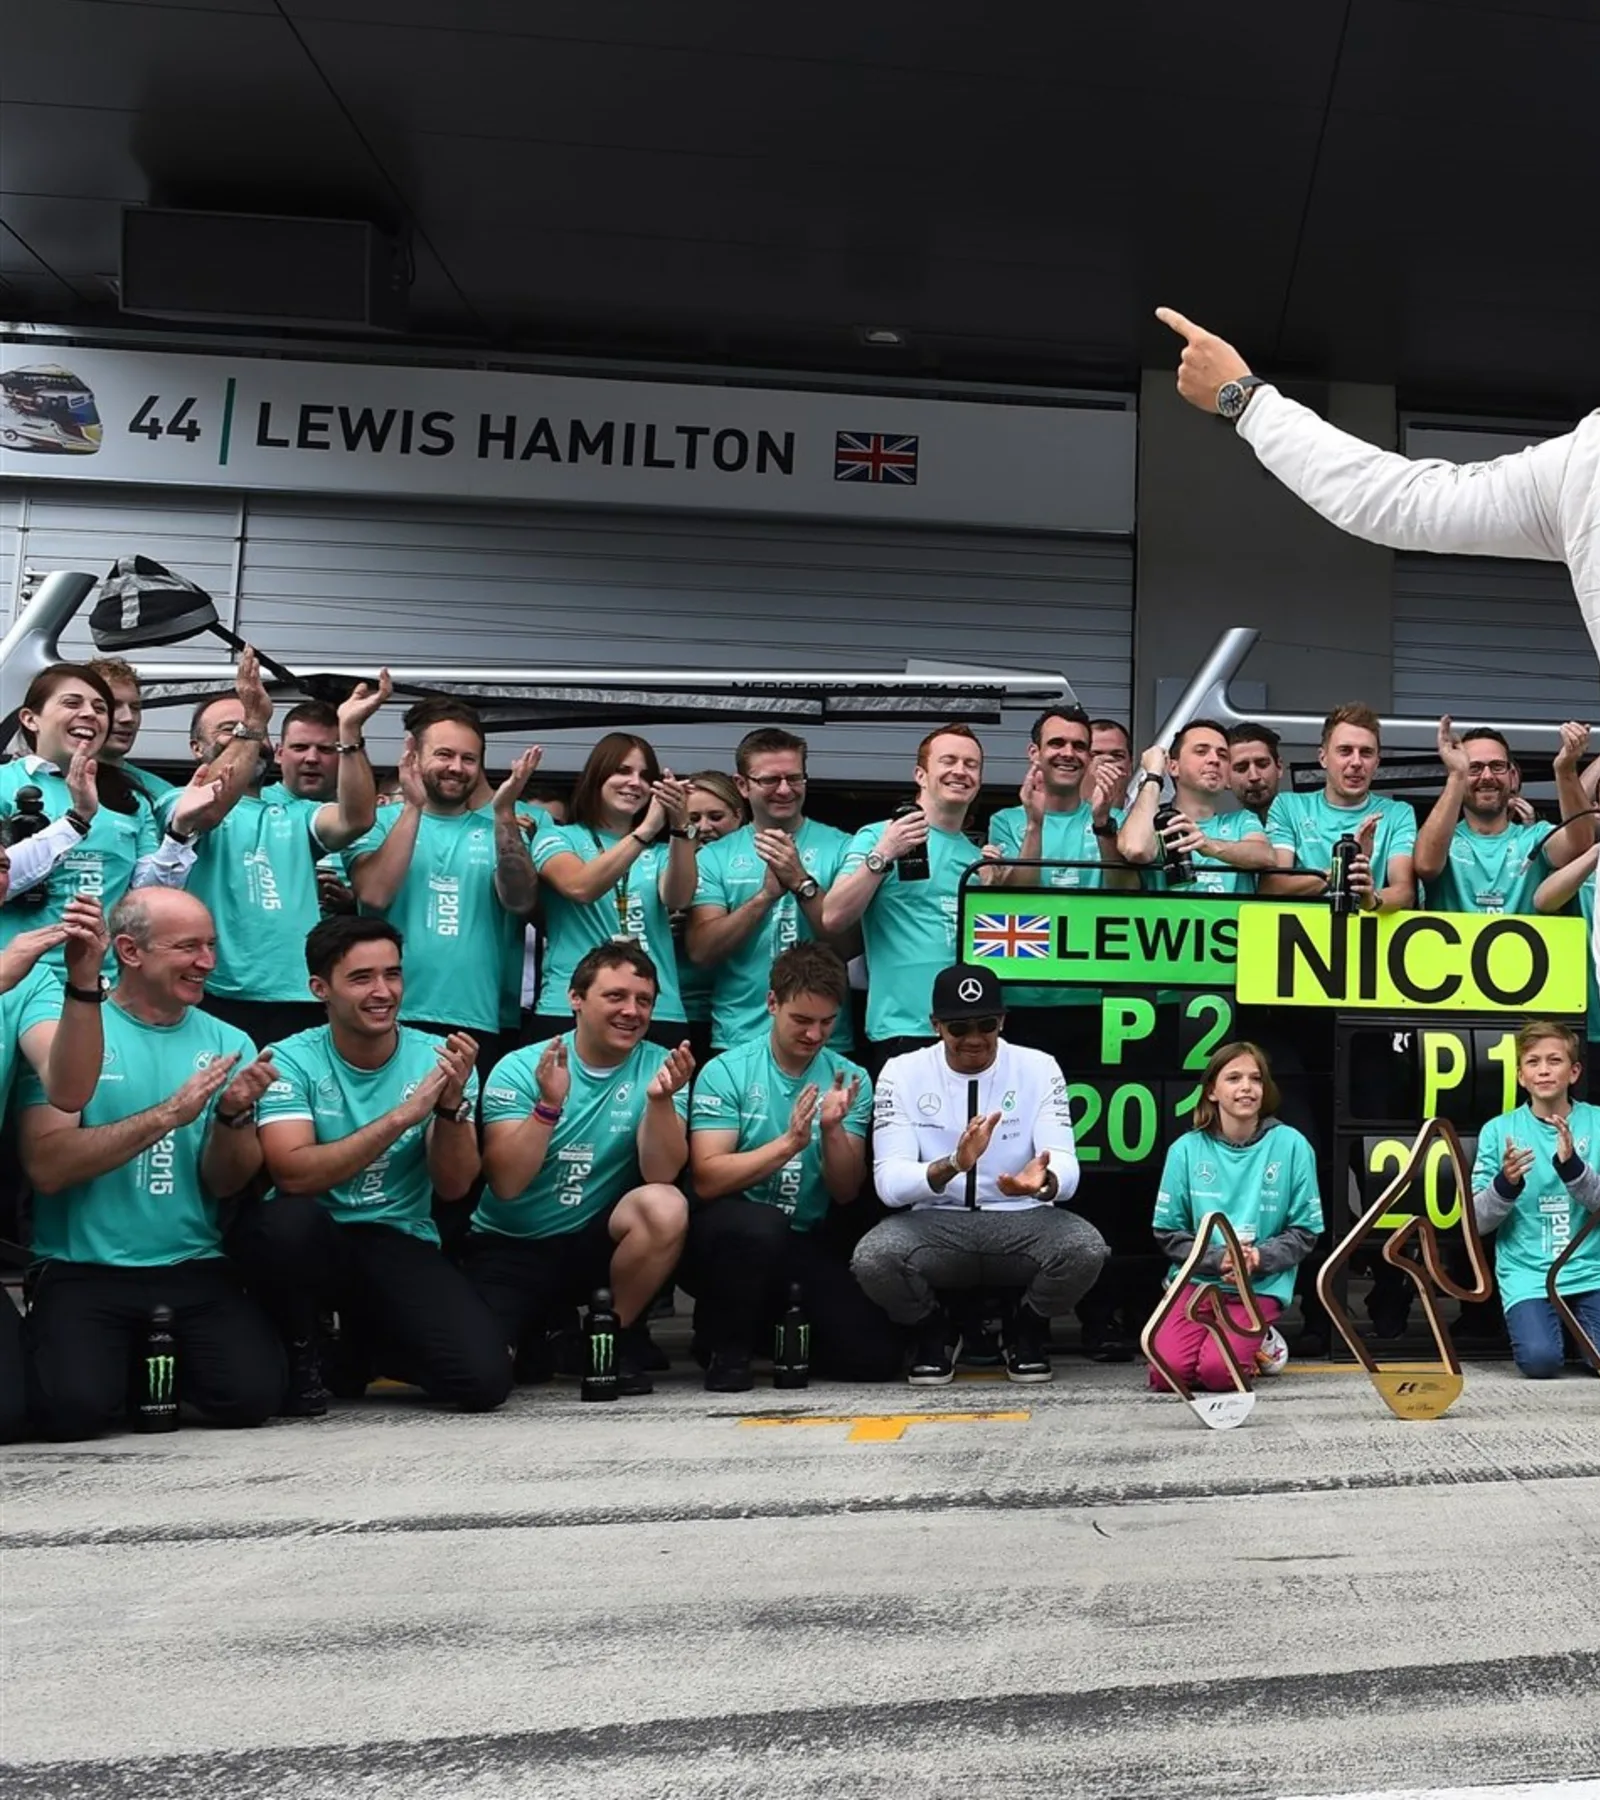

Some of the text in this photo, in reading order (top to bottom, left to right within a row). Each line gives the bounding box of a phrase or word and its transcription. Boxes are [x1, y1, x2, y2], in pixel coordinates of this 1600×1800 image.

[128, 395, 201, 442] 44
[256, 402, 796, 475] LEWIS HAMILTON
[258, 865, 282, 911] 2015
[437, 894, 459, 937] 2015
[1056, 915, 1239, 963] LEWIS
[1276, 913, 1551, 1007] NICO
[149, 1136, 176, 1195] 2015
